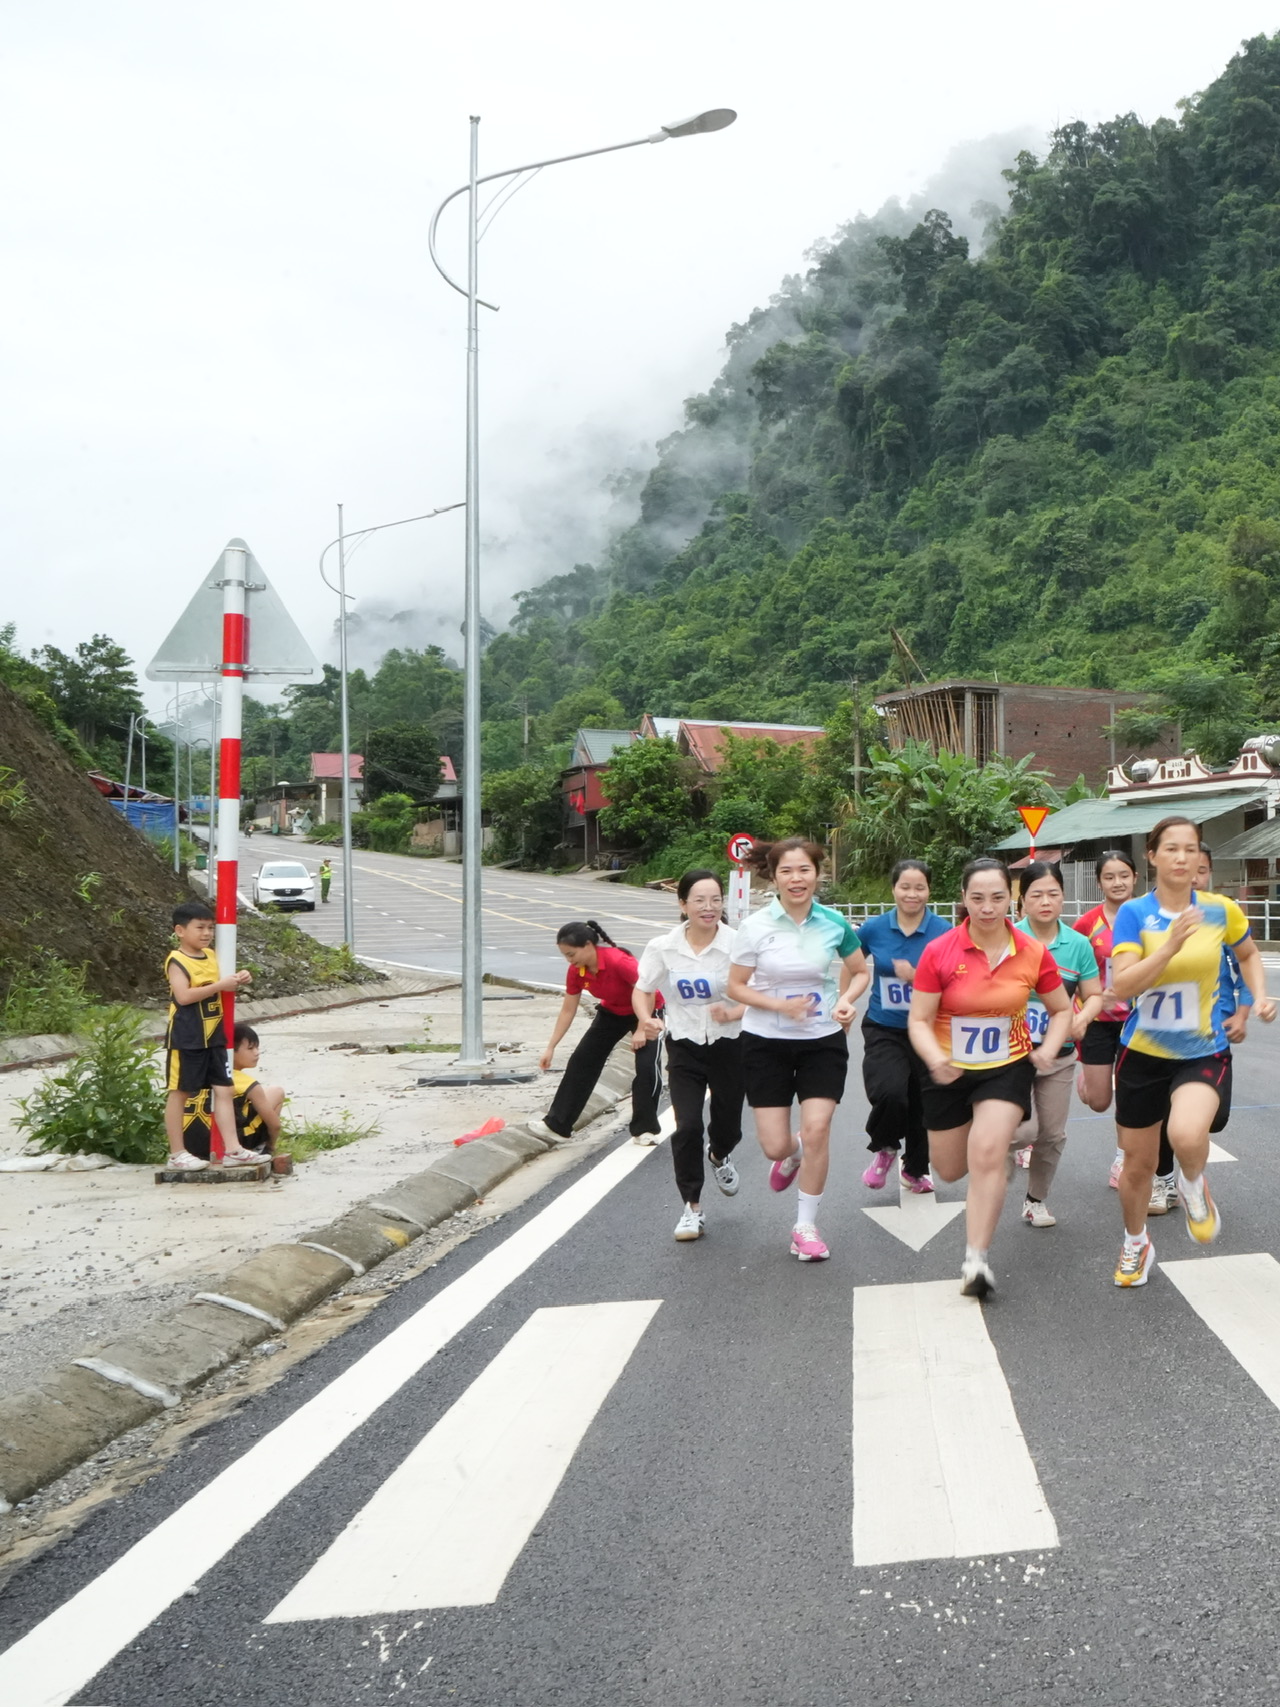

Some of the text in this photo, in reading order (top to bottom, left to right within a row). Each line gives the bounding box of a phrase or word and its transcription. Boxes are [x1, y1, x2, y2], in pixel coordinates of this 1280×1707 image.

[677, 978, 712, 999] 69
[786, 992, 822, 1018] 2
[1147, 991, 1183, 1020] 71
[1027, 1008, 1049, 1036] 68
[961, 1026, 1001, 1055] 70
